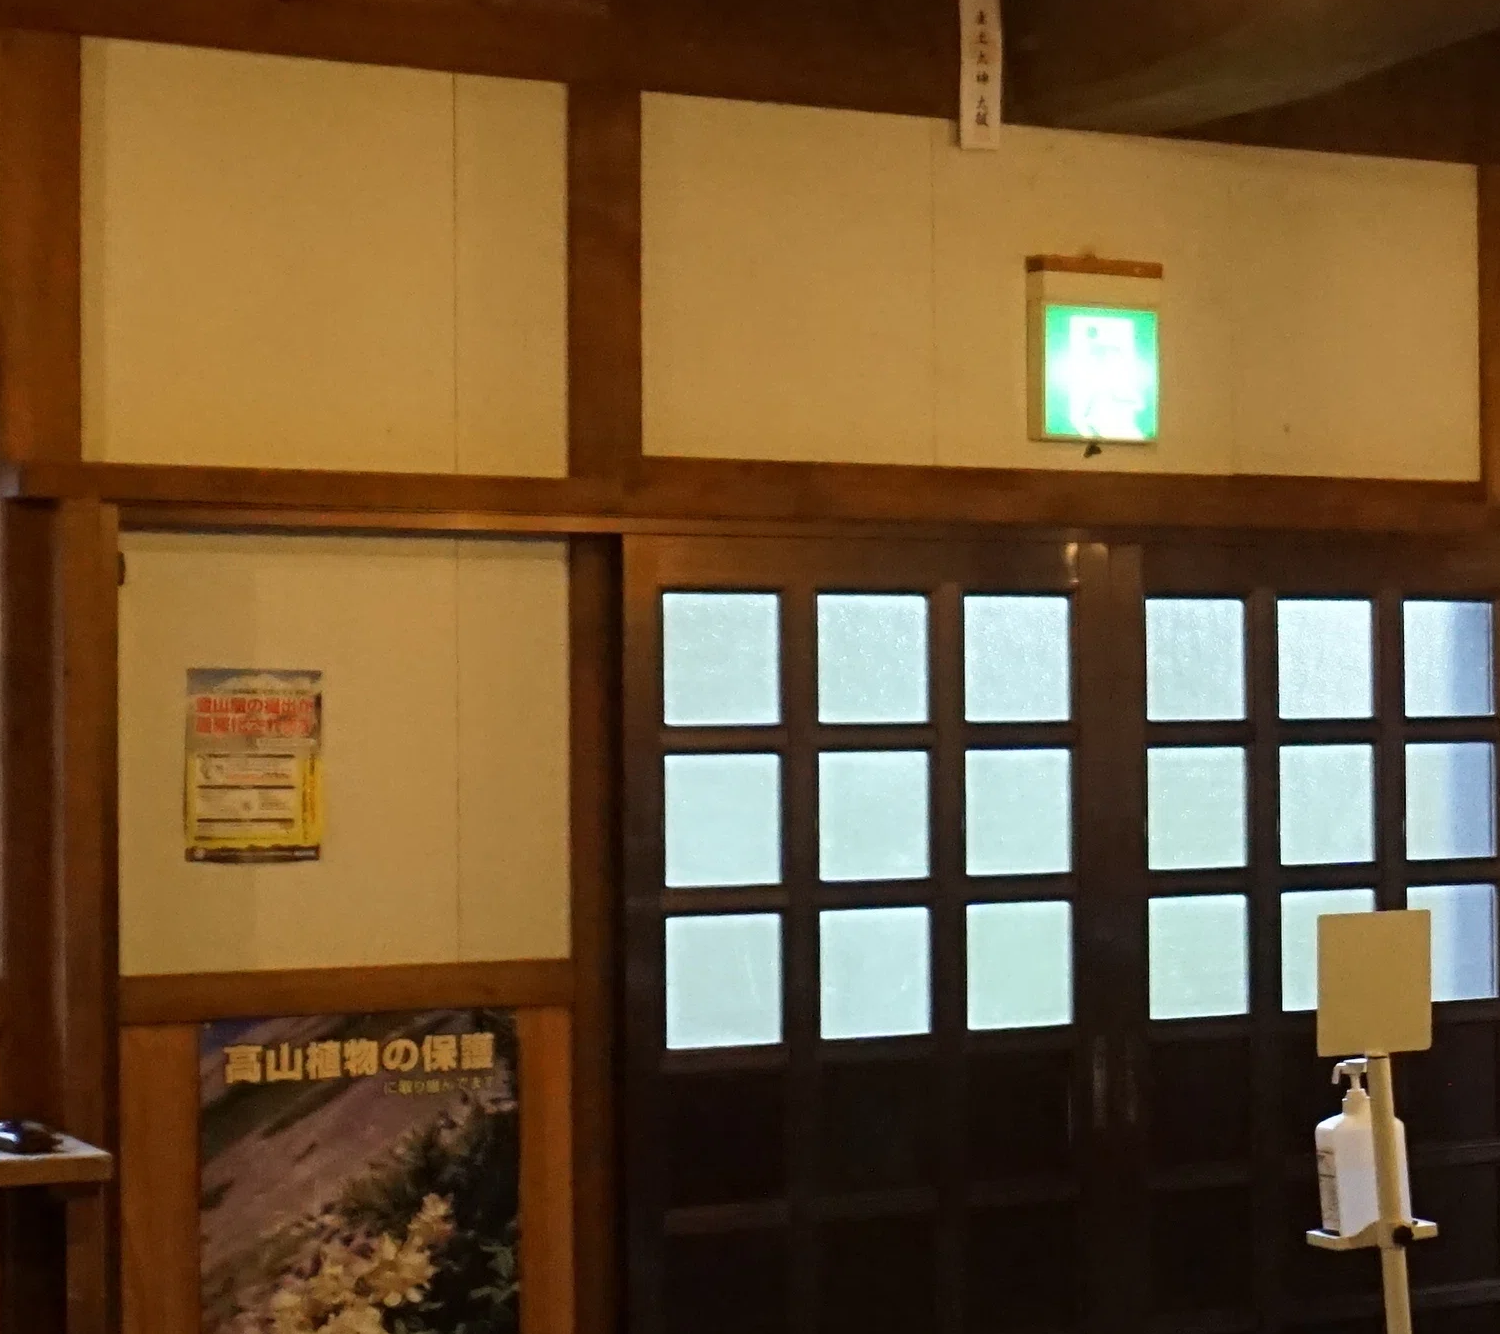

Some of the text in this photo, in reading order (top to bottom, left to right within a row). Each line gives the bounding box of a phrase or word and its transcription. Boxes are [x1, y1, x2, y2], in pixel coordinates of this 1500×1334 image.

[224, 1032, 495, 1084] 高山植物の保護
